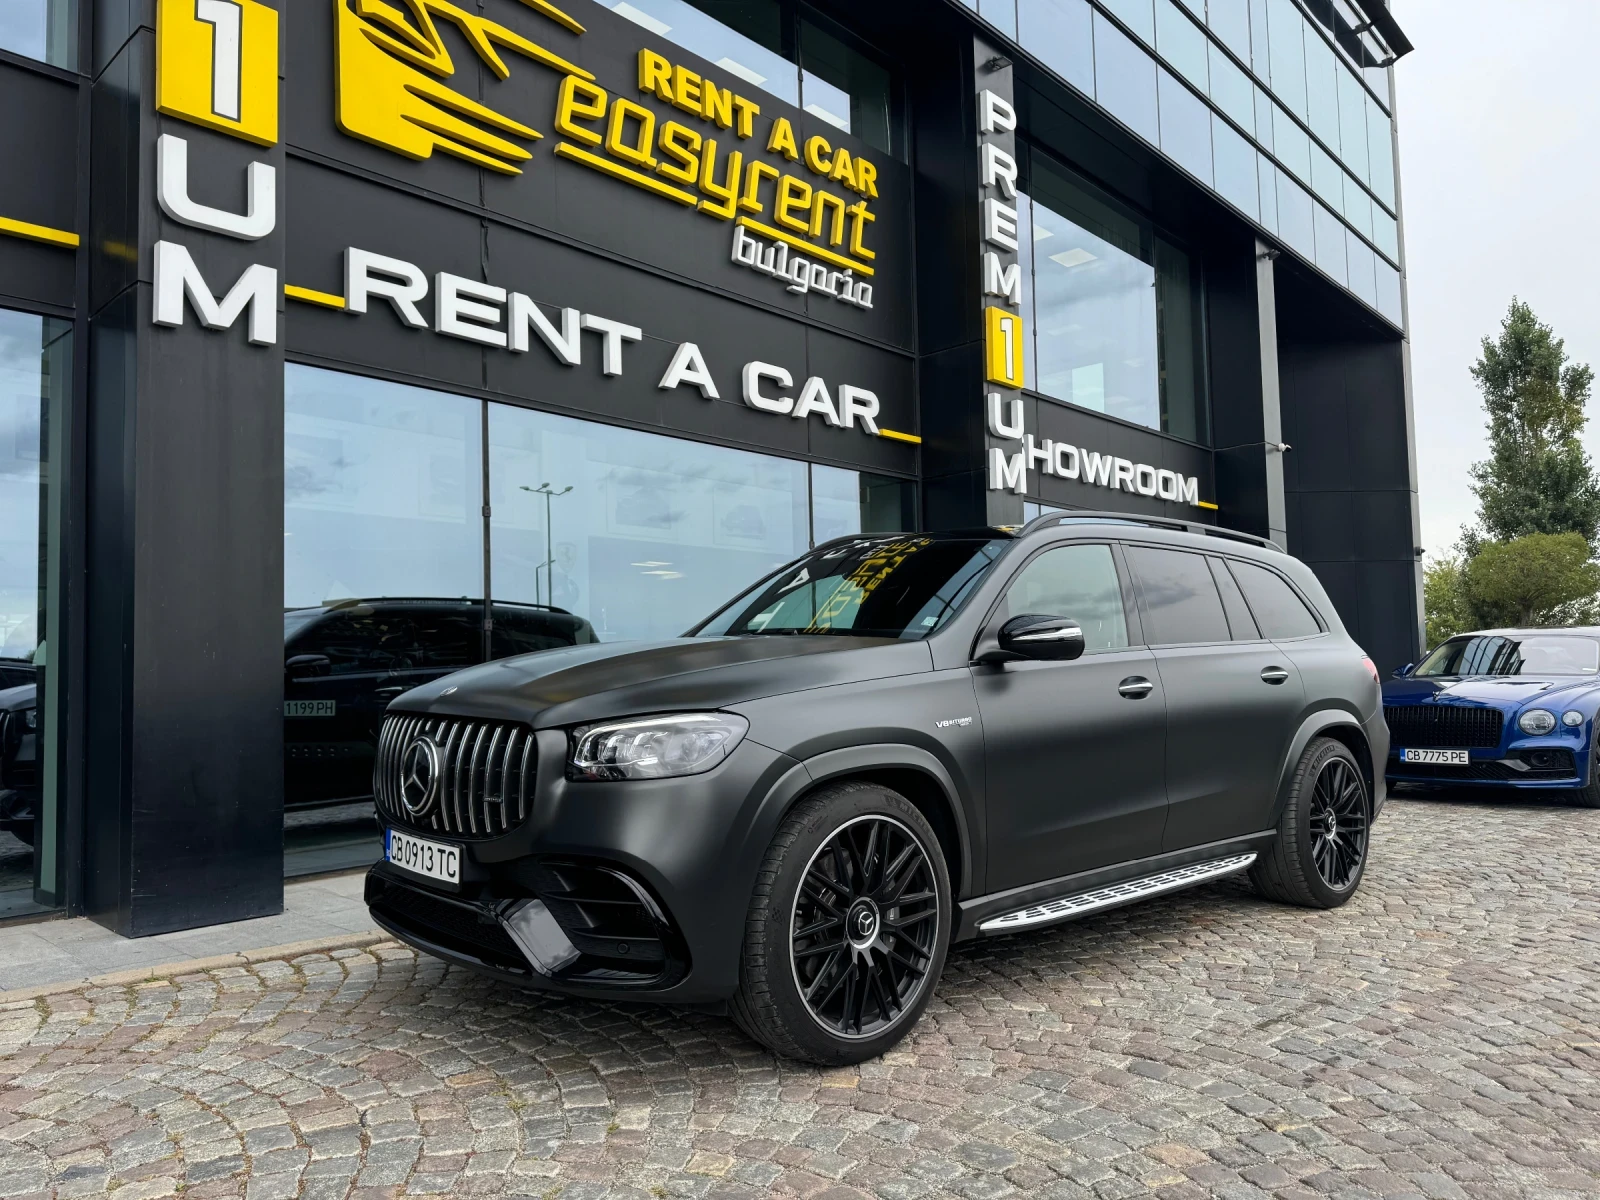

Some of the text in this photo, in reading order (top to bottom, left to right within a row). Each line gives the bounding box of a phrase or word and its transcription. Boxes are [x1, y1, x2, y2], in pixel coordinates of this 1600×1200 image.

[638, 47, 879, 198] RENT A CAR
[554, 74, 876, 260] easyrent
[731, 225, 874, 309] bulgaria
[980, 88, 1028, 494] PREM1UM
[343, 246, 881, 435] RENT A CAR
[1022, 433, 1199, 506] HOWROOM
[286, 702, 333, 715] 1199 PH
[1406, 750, 1467, 763] CB 7775 PE
[391, 834, 457, 878] CB 0913 TC
